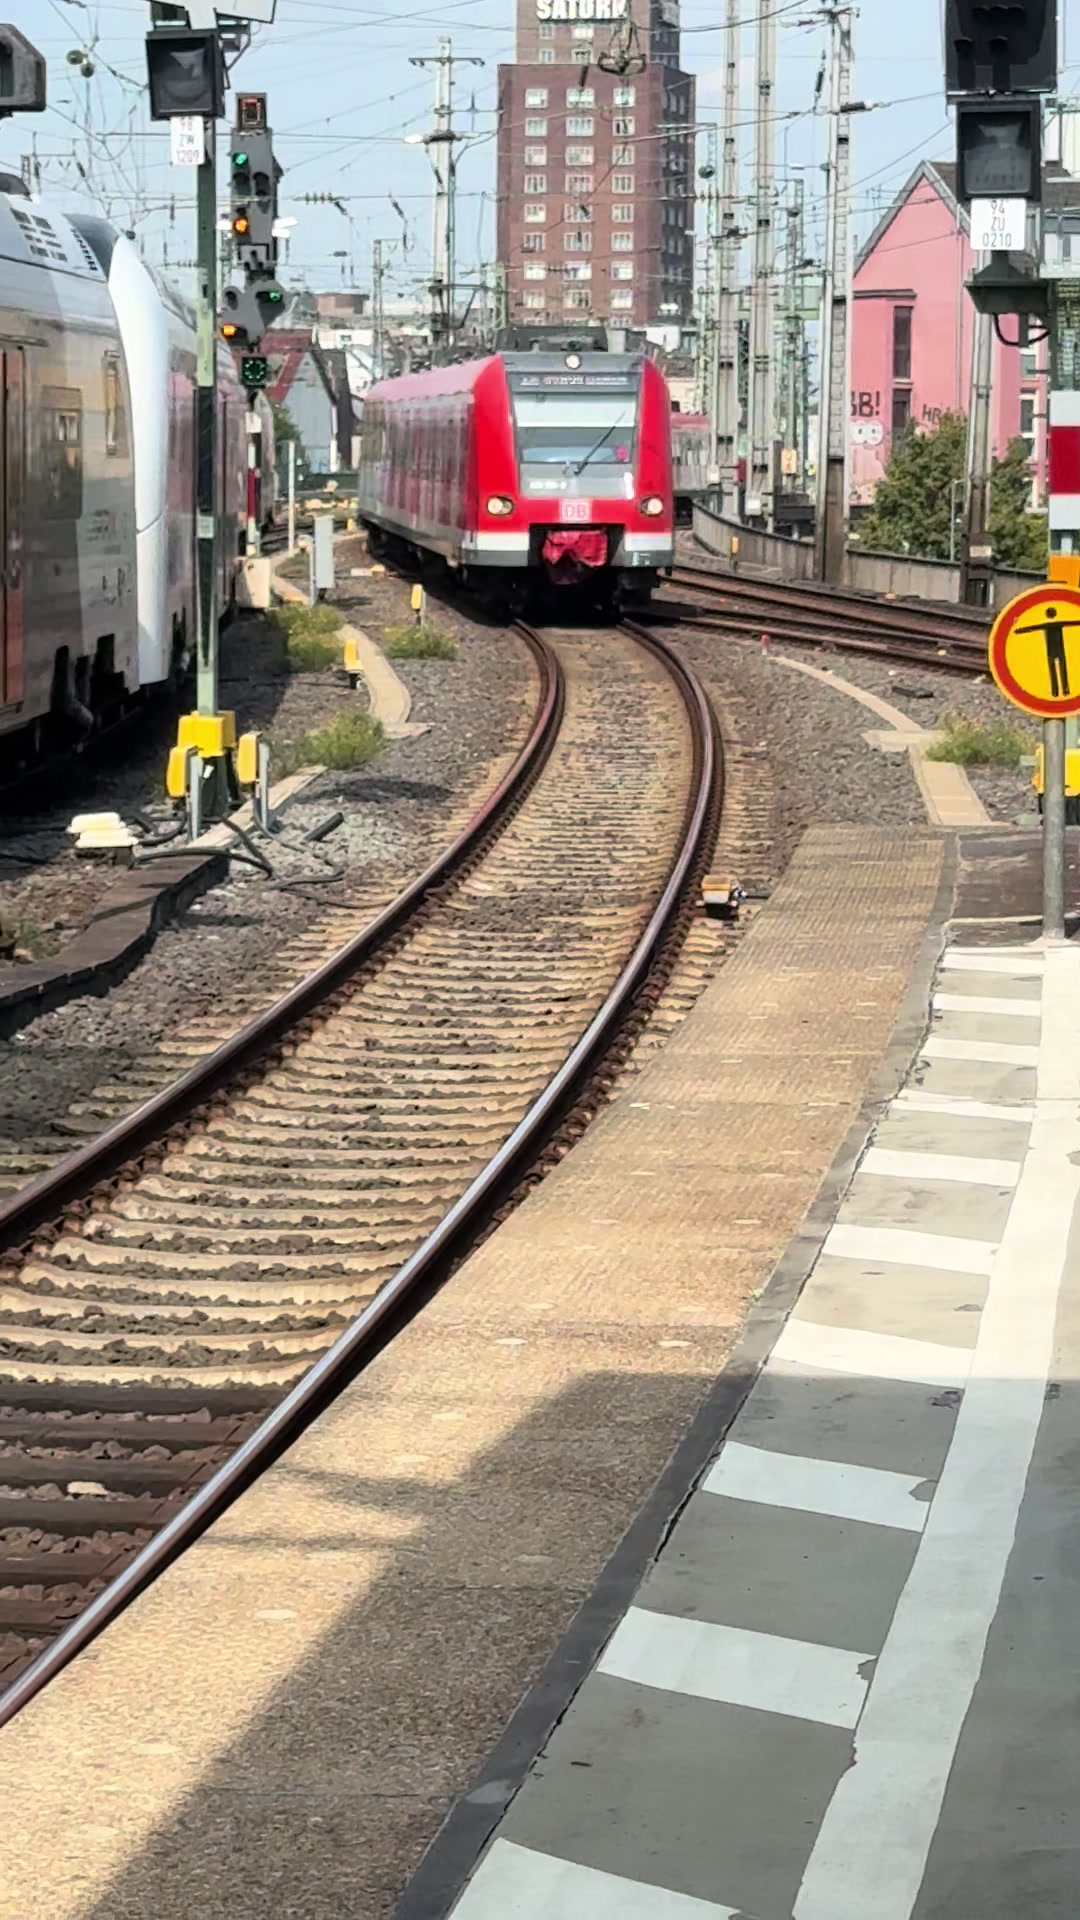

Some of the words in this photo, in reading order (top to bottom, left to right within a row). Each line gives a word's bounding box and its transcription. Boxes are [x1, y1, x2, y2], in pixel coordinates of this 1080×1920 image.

[990, 216, 1006, 231] ZU
[982, 232, 1012, 248] 0210
[564, 503, 588, 519] DB
